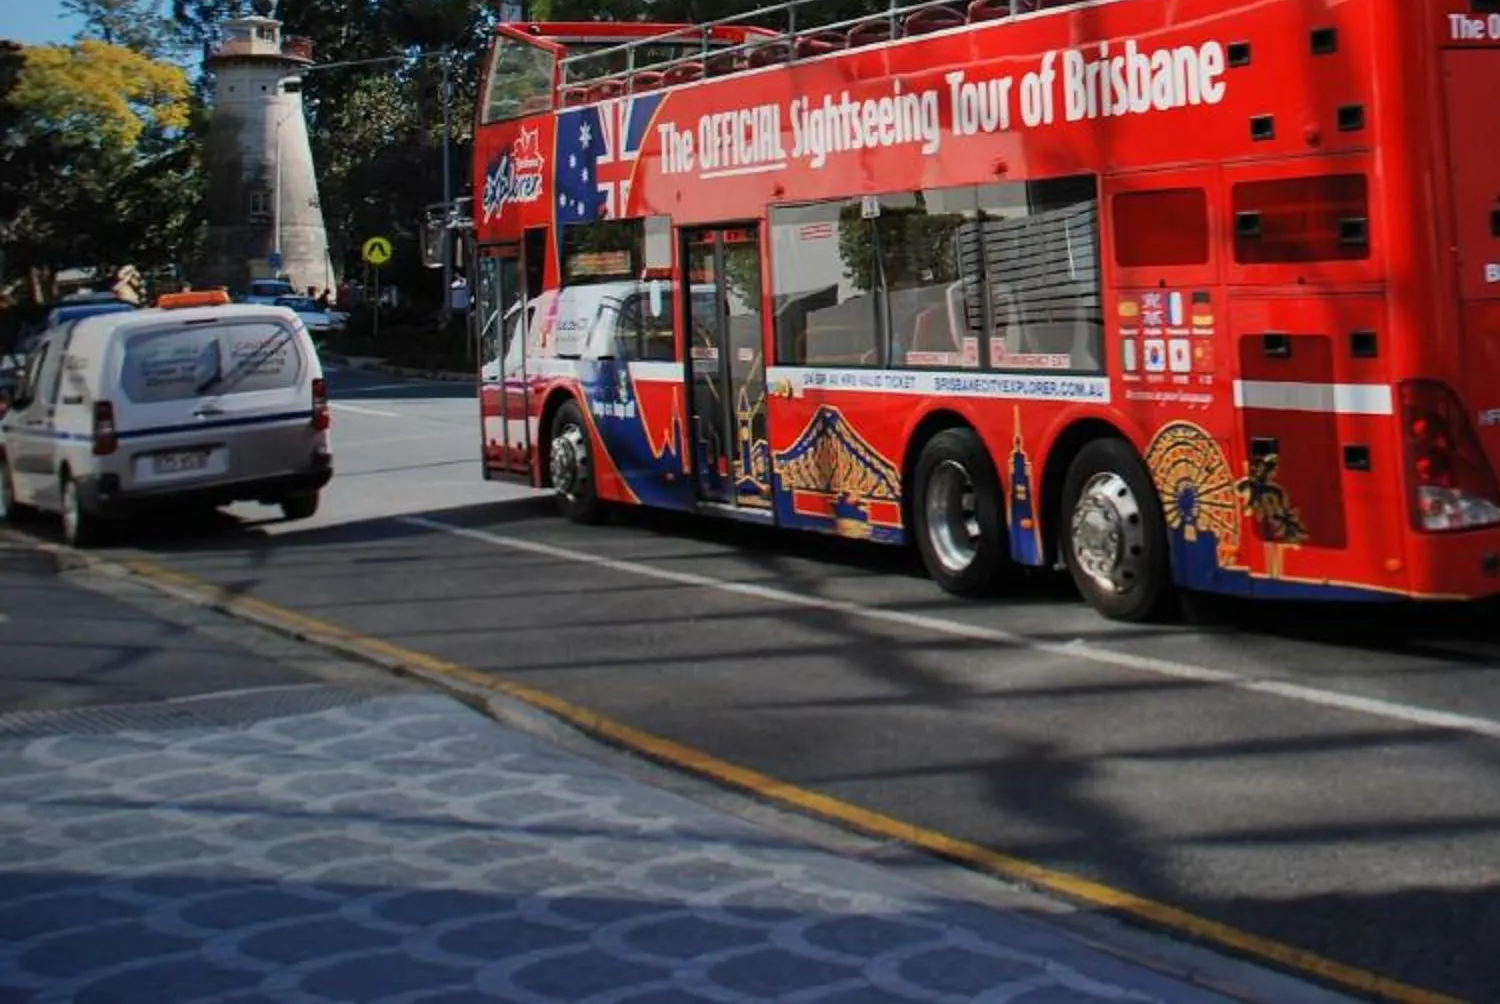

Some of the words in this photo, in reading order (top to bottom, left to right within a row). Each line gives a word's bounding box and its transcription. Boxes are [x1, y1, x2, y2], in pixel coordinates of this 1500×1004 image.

[1448, 13, 1486, 40] The
[657, 122, 697, 174] The
[698, 103, 788, 174] OFFICIAL
[790, 81, 940, 169] Sightseeing
[945, 69, 1010, 137] Tour
[1020, 49, 1056, 128] of
[1063, 39, 1227, 123] Brisbane
[884, 374, 918, 389] TICKET
[933, 376, 1105, 398] BRISBANECITYEXPLORER.COM.AU
